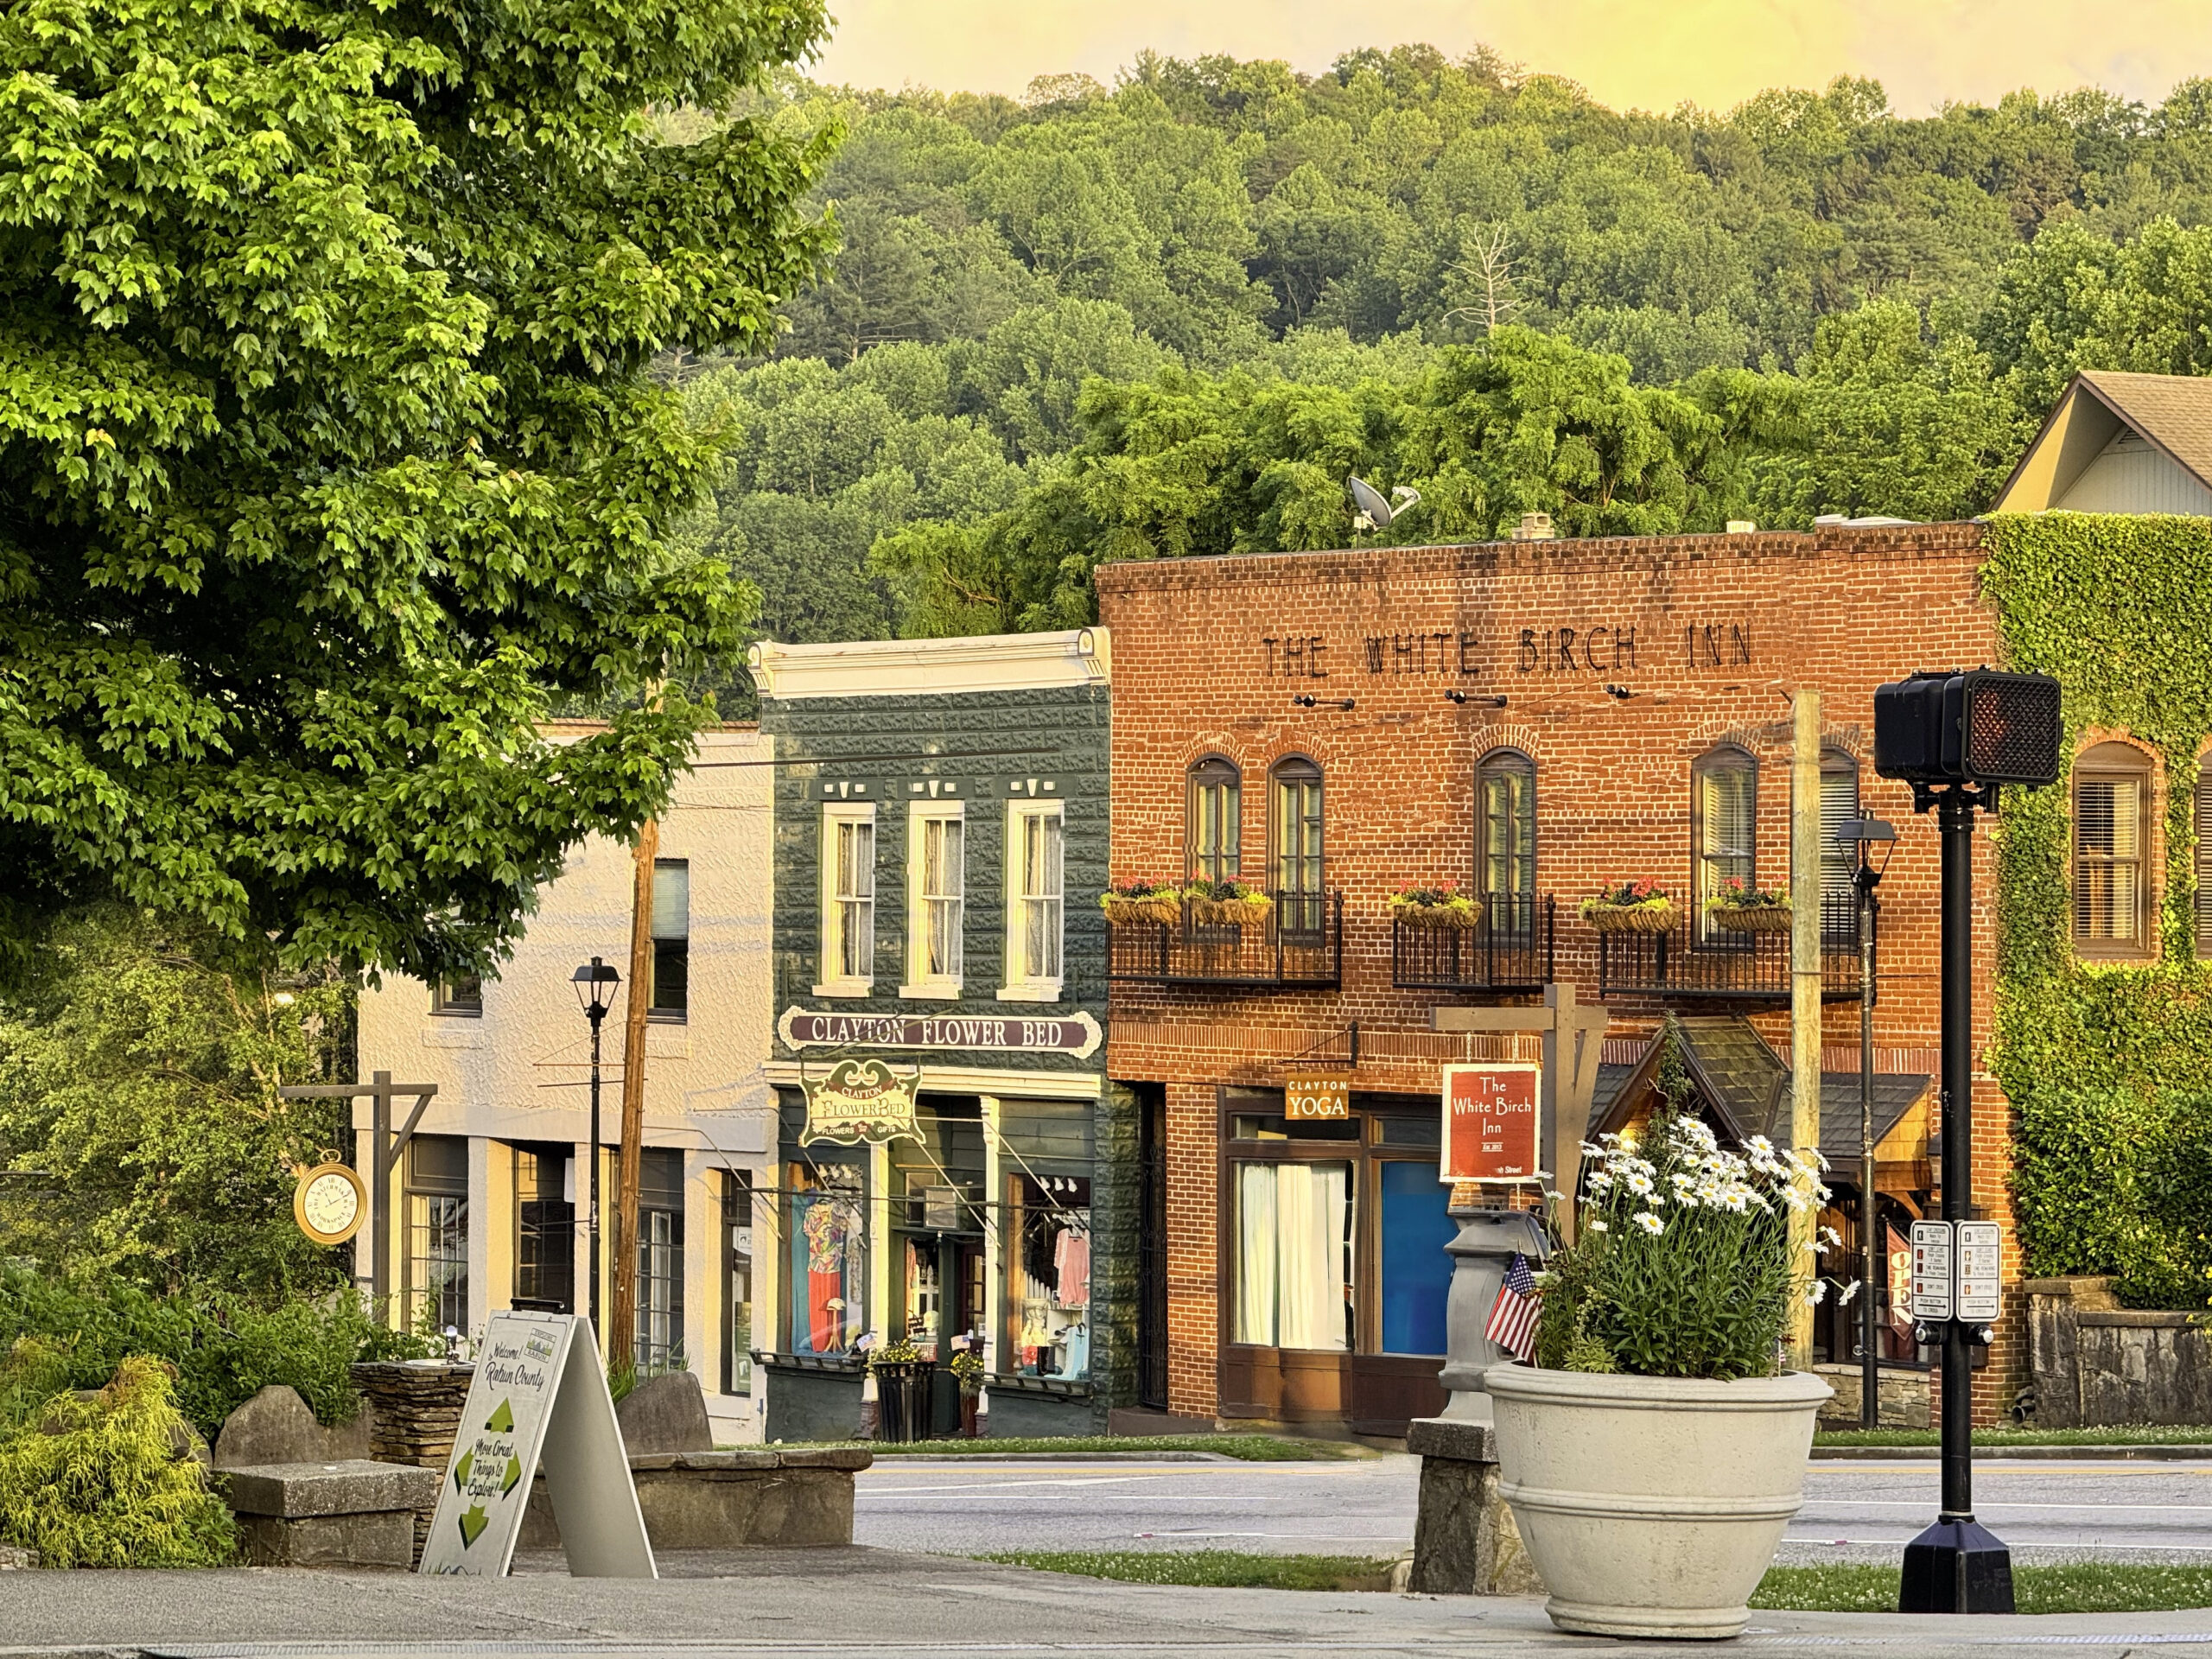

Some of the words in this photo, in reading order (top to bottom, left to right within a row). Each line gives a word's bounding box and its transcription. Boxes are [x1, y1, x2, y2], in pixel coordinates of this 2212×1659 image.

[1262, 636, 1328, 677] THE
[1365, 632, 1481, 675] WHITE
[1518, 626, 1638, 672] BIRCH
[1686, 623, 1751, 668] INN
[811, 1017, 906, 1044] CLAYTON
[921, 1020, 1007, 1046] FLOWER
[1021, 1022, 1062, 1047] BED
[842, 1085, 883, 1099] CLAYTON
[1288, 1080, 1347, 1090] CLAYTON
[1478, 1076, 1507, 1095] The
[1288, 1096, 1346, 1116] YOGA
[1452, 1096, 1491, 1116] White
[1496, 1096, 1532, 1116] Birch
[822, 1127, 855, 1135] FLOWERS
[1482, 1117, 1502, 1136] Inn
[1504, 1166, 1522, 1174] Street
[1891, 1251, 1913, 1326] OPEN
[494, 1341, 524, 1360] Welcome!
[527, 1349, 547, 1361] RABUN
[485, 1361, 513, 1391] Rabun
[515, 1363, 545, 1392] County
[474, 1438, 493, 1457] More
[493, 1440, 514, 1458] Great
[474, 1459, 495, 1480] Things
[496, 1460, 503, 1478] to
[467, 1478, 500, 1502] Explore!
